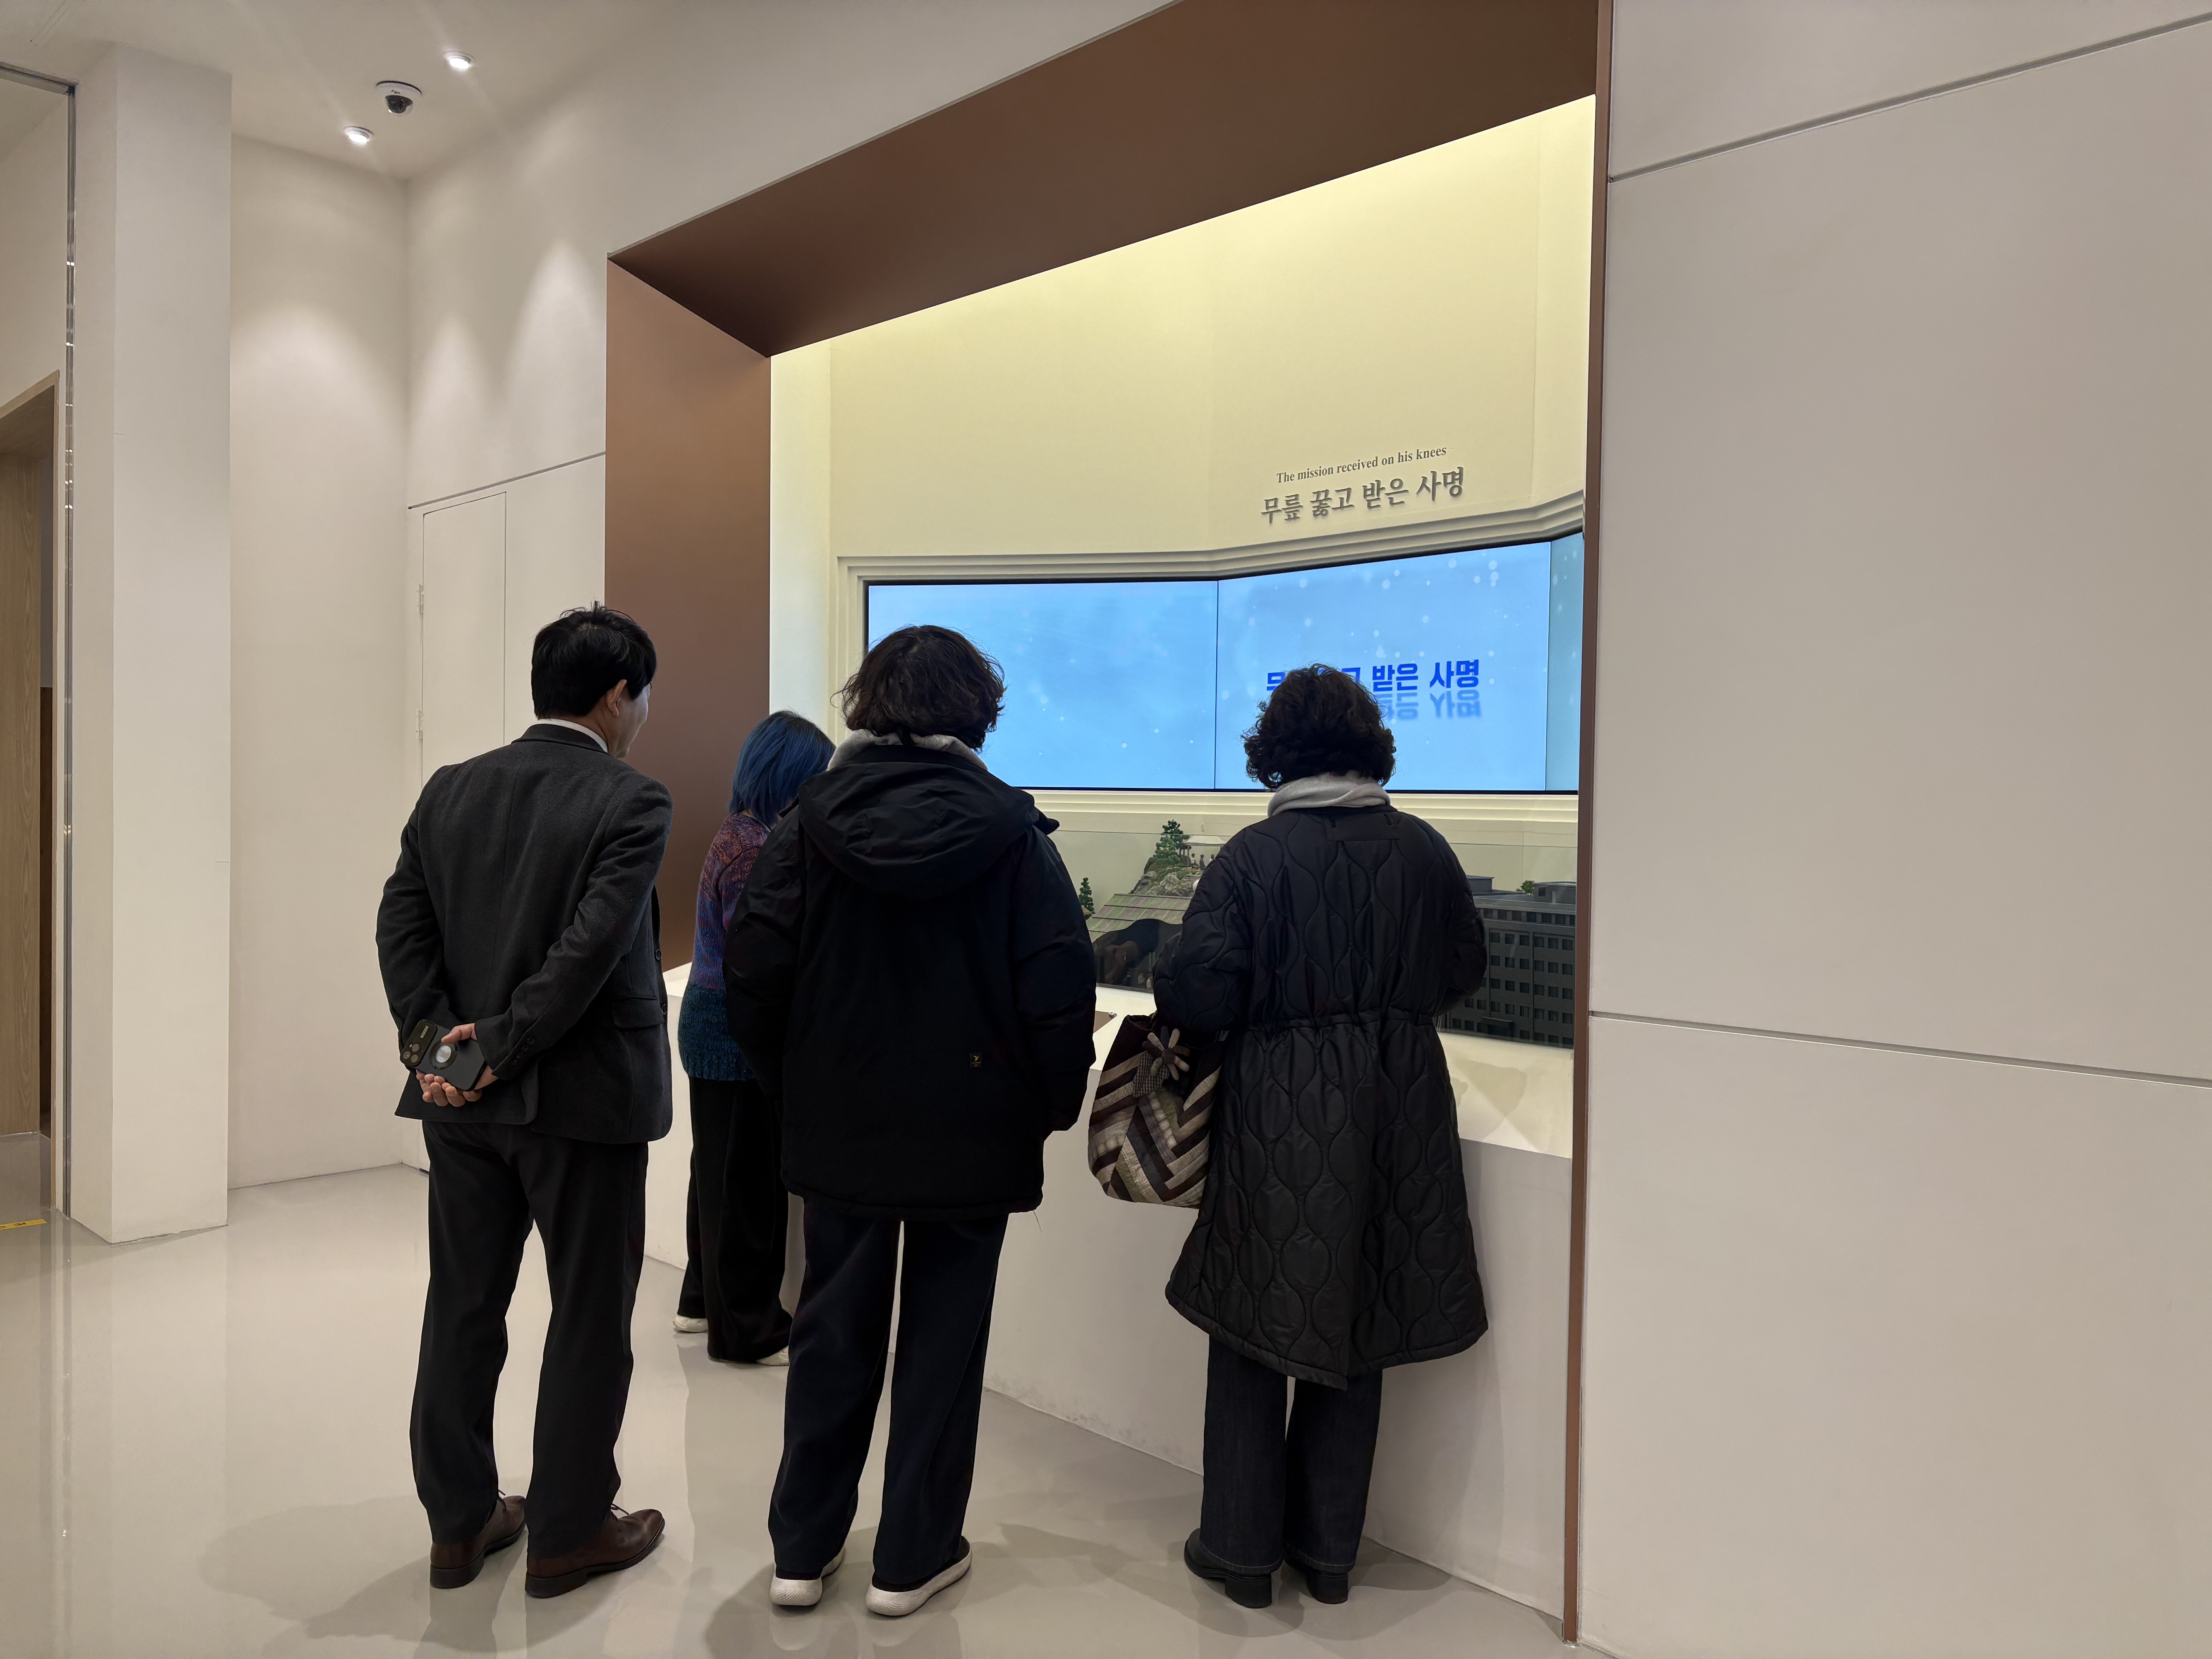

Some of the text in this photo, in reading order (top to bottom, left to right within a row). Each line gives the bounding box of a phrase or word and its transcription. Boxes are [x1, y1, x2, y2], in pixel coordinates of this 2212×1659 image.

[1277, 447, 1446, 483] The mission received on his knees
[1261, 467, 1464, 524] 무릎 꿇고 받은 사명
[1372, 663, 1419, 692] 받은
[1430, 659, 1479, 689] 사명
